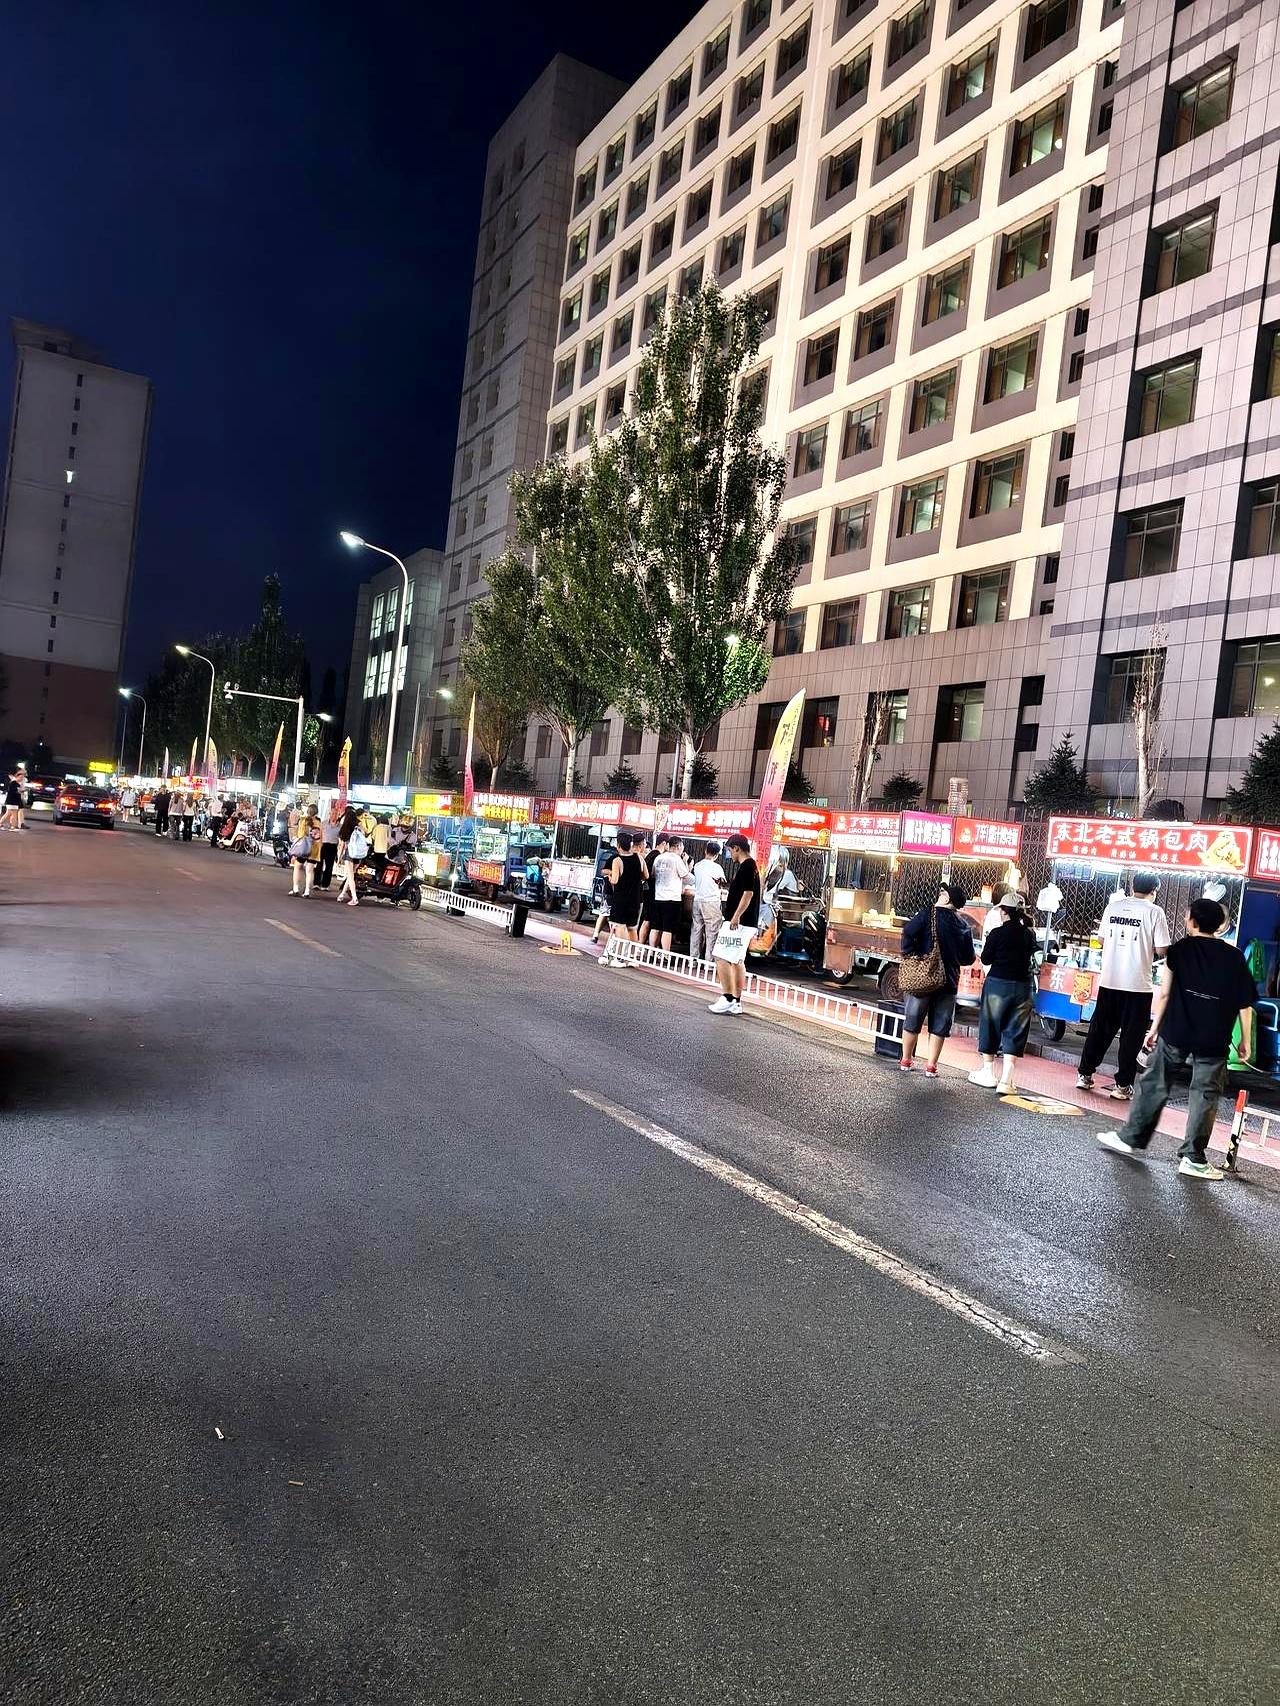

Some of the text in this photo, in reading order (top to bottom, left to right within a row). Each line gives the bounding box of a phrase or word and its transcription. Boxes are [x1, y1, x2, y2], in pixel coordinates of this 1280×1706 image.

[1054, 822, 1208, 851] 东北老式锅包肉
[1110, 916, 1142, 927] GNOMES
